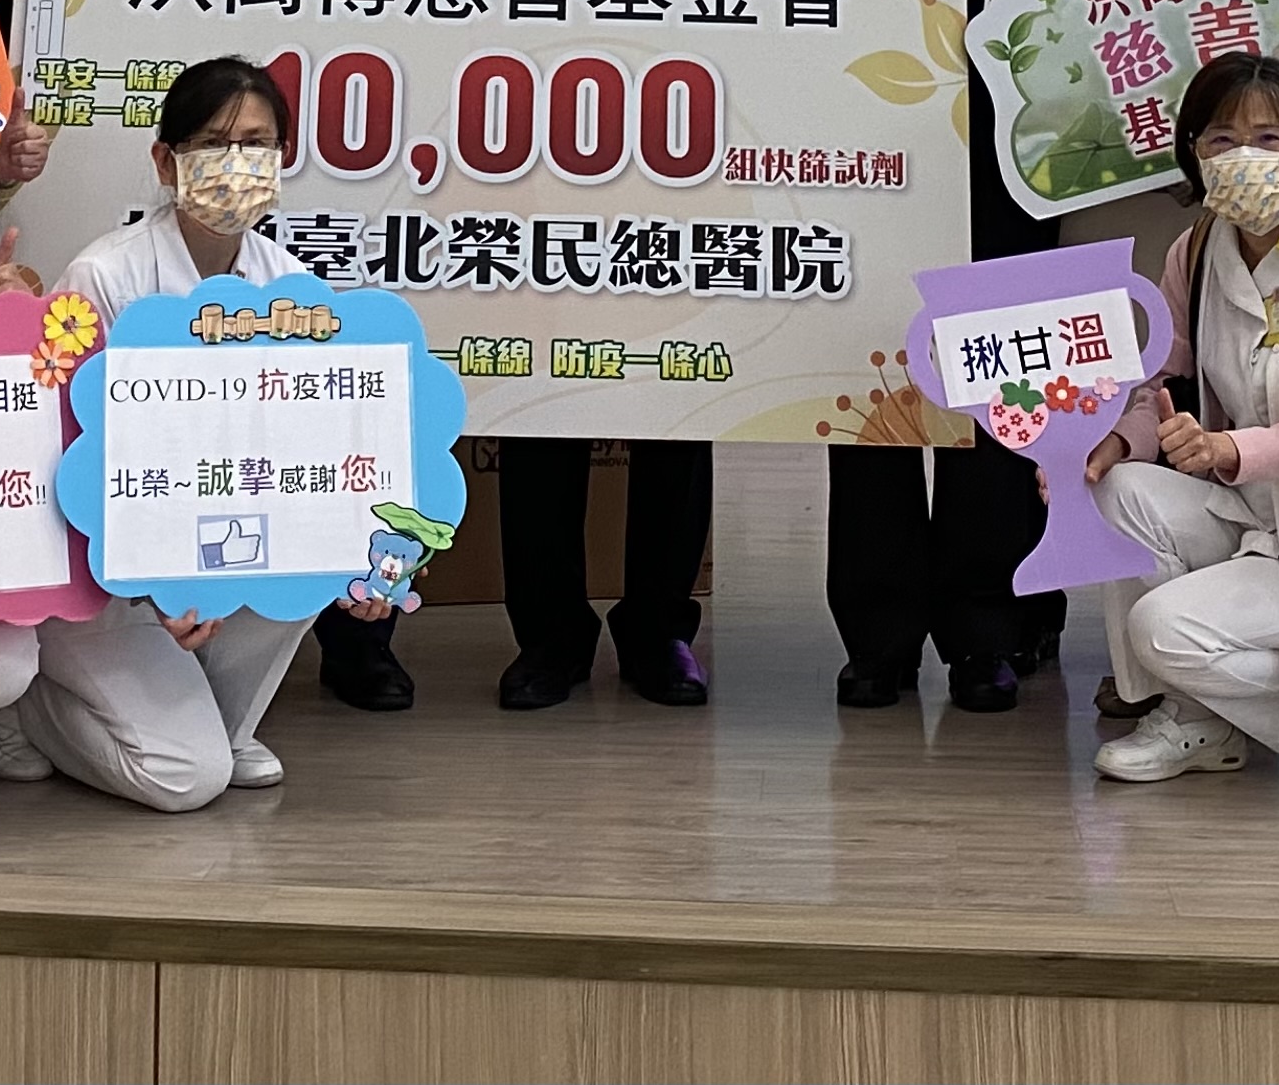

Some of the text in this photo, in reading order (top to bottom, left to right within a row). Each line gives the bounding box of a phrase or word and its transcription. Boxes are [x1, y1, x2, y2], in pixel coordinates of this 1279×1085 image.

[32, 94, 164, 127] 防疫一條
[725, 147, 905, 187] 組快篩試劑
[550, 338, 734, 382] 防疫一條心
[960, 313, 1113, 383] 揪甘溫
[110, 367, 386, 403] COVID-19 抗疫相挺
